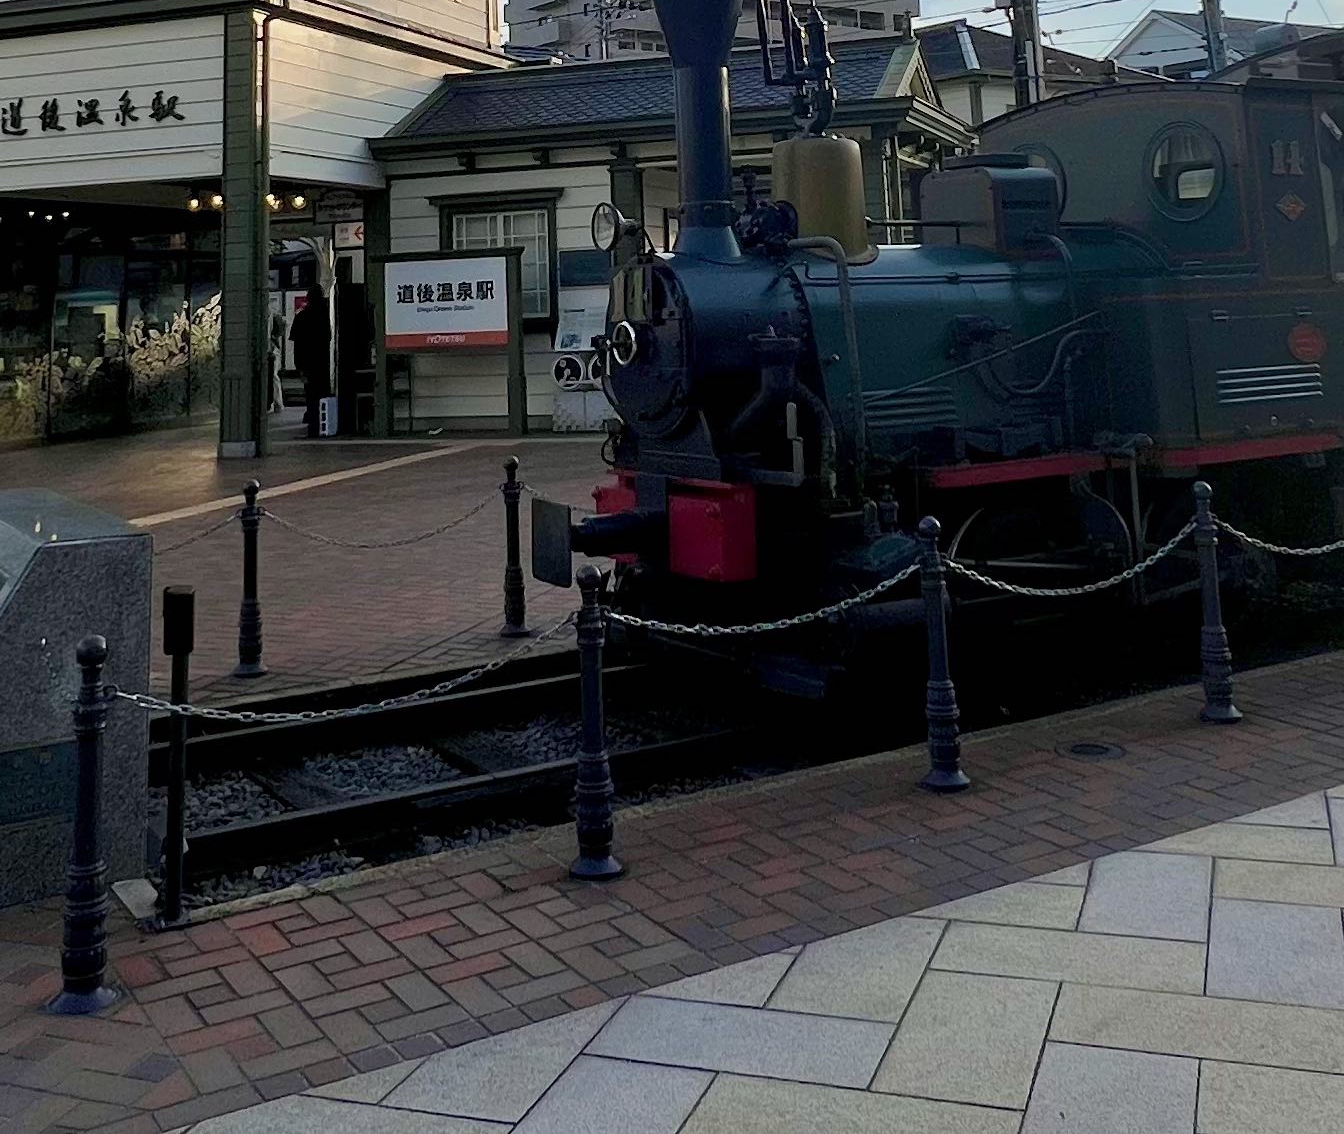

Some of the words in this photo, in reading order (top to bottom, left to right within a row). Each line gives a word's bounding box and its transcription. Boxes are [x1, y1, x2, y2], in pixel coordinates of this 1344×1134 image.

[0, 89, 186, 136] 道後温泉駅
[1271, 139, 1304, 176] 14
[397, 280, 495, 304] 道後温泉駅
